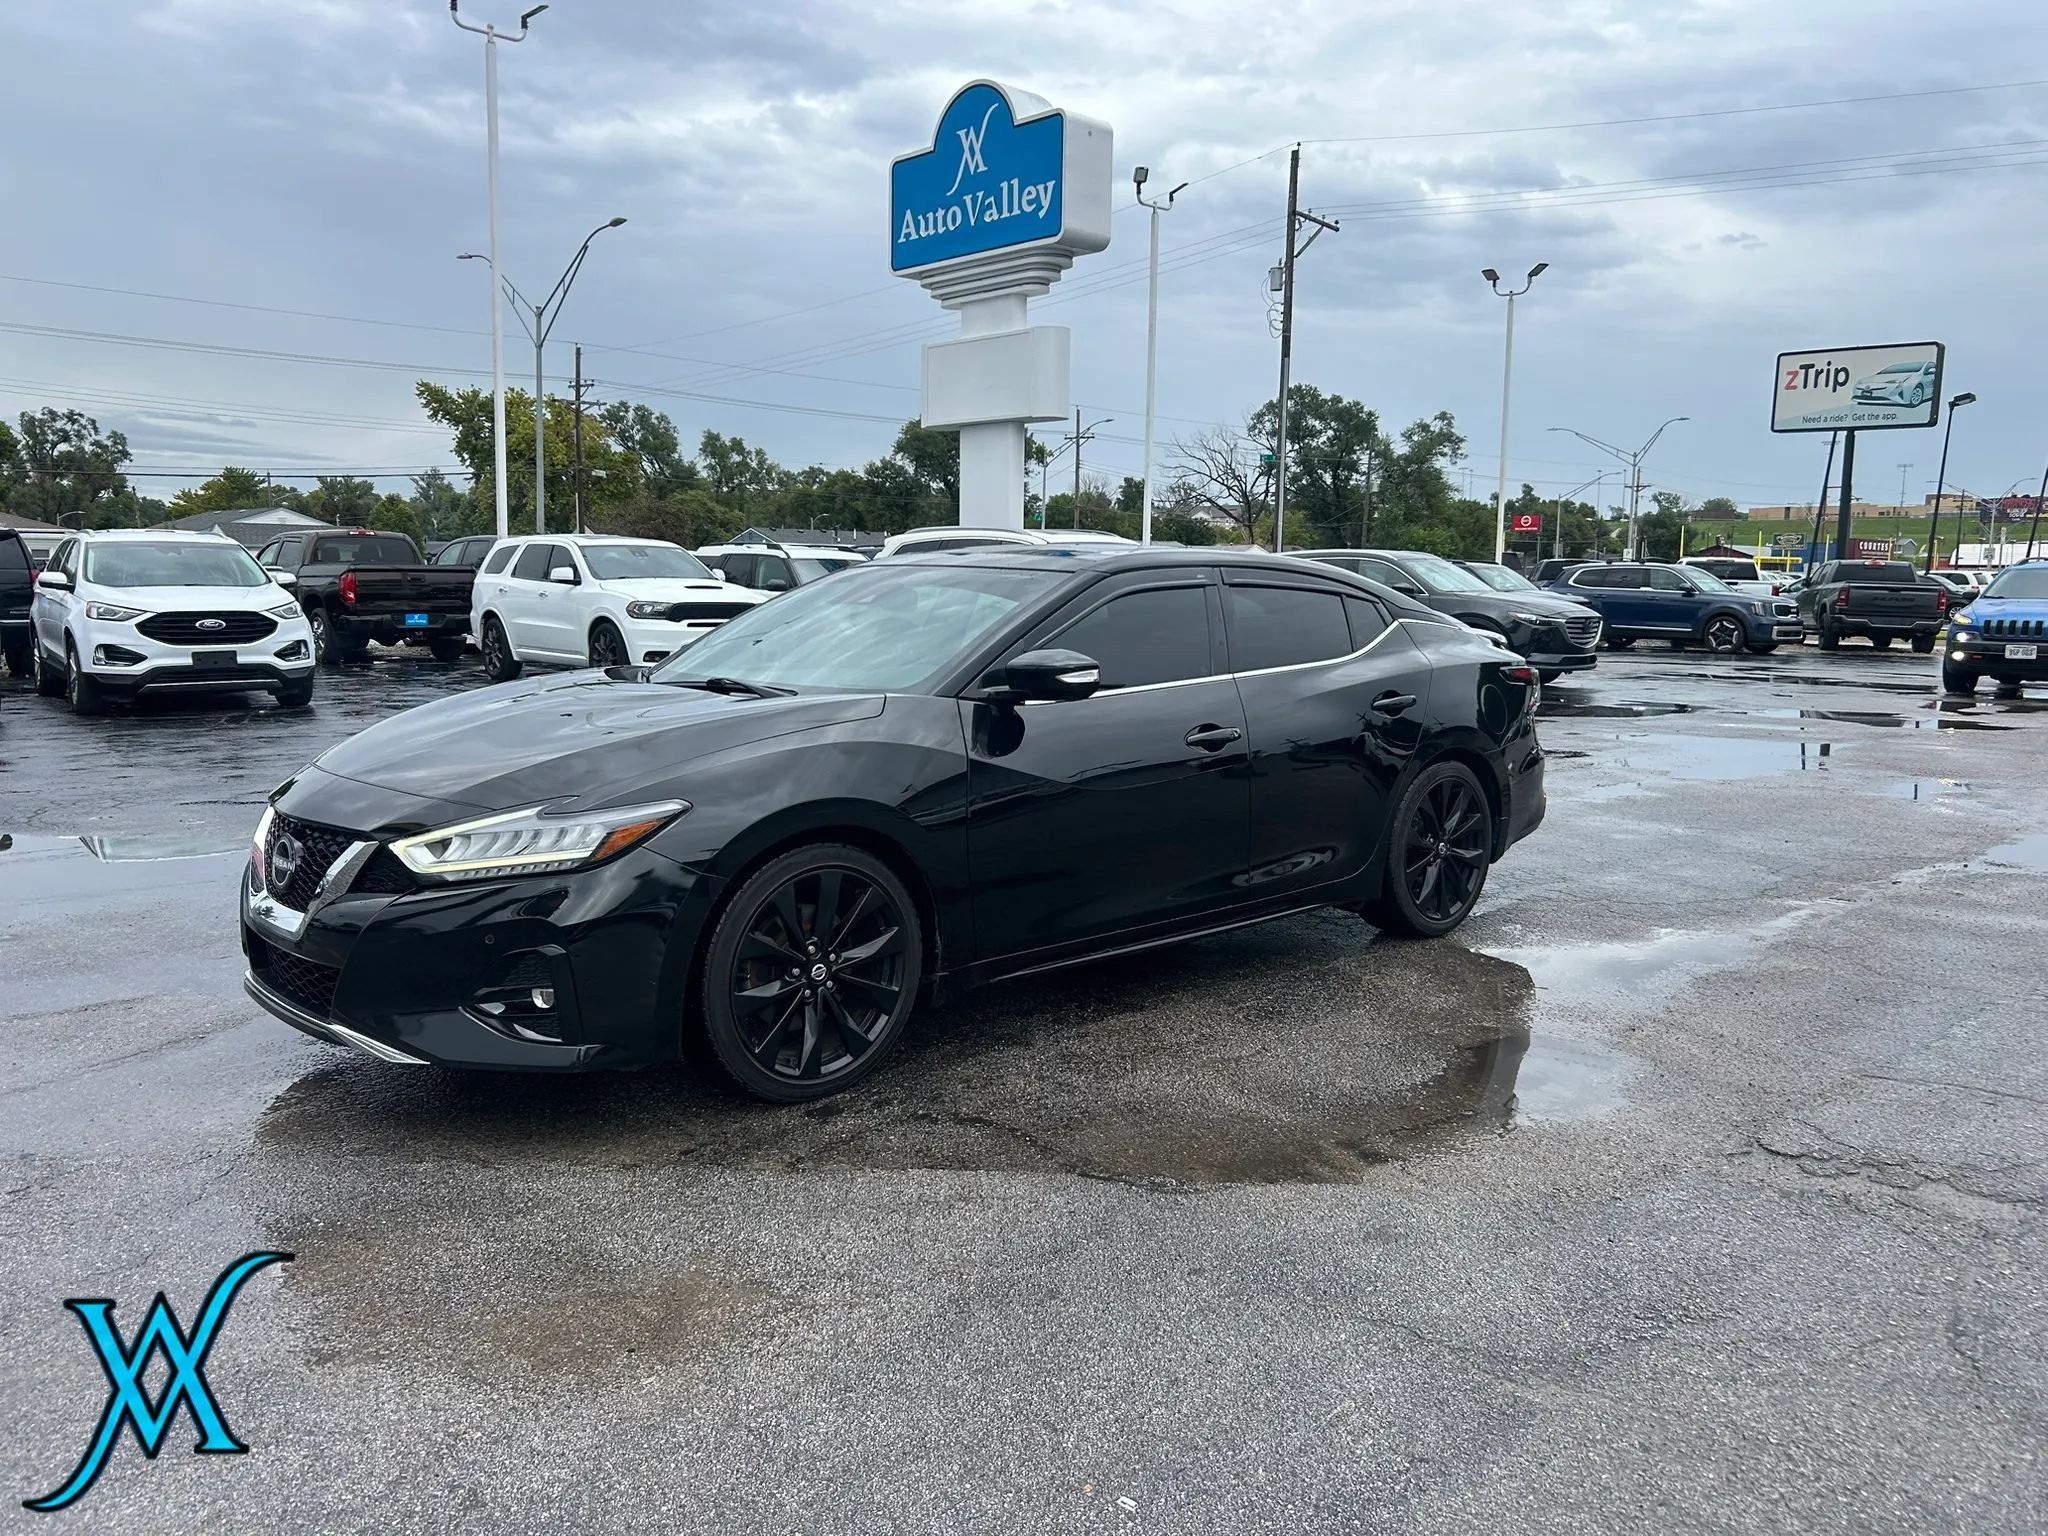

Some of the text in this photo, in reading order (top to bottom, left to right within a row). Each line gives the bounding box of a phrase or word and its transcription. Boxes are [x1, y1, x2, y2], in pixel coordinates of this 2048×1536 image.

[1784, 360, 1850, 393] zTrip
[1802, 415, 1822, 424] Need
[1829, 413, 1849, 423] ride?
[1851, 413, 1866, 422] Get
[1867, 411, 1880, 421] the
[1881, 411, 1899, 422] app.
